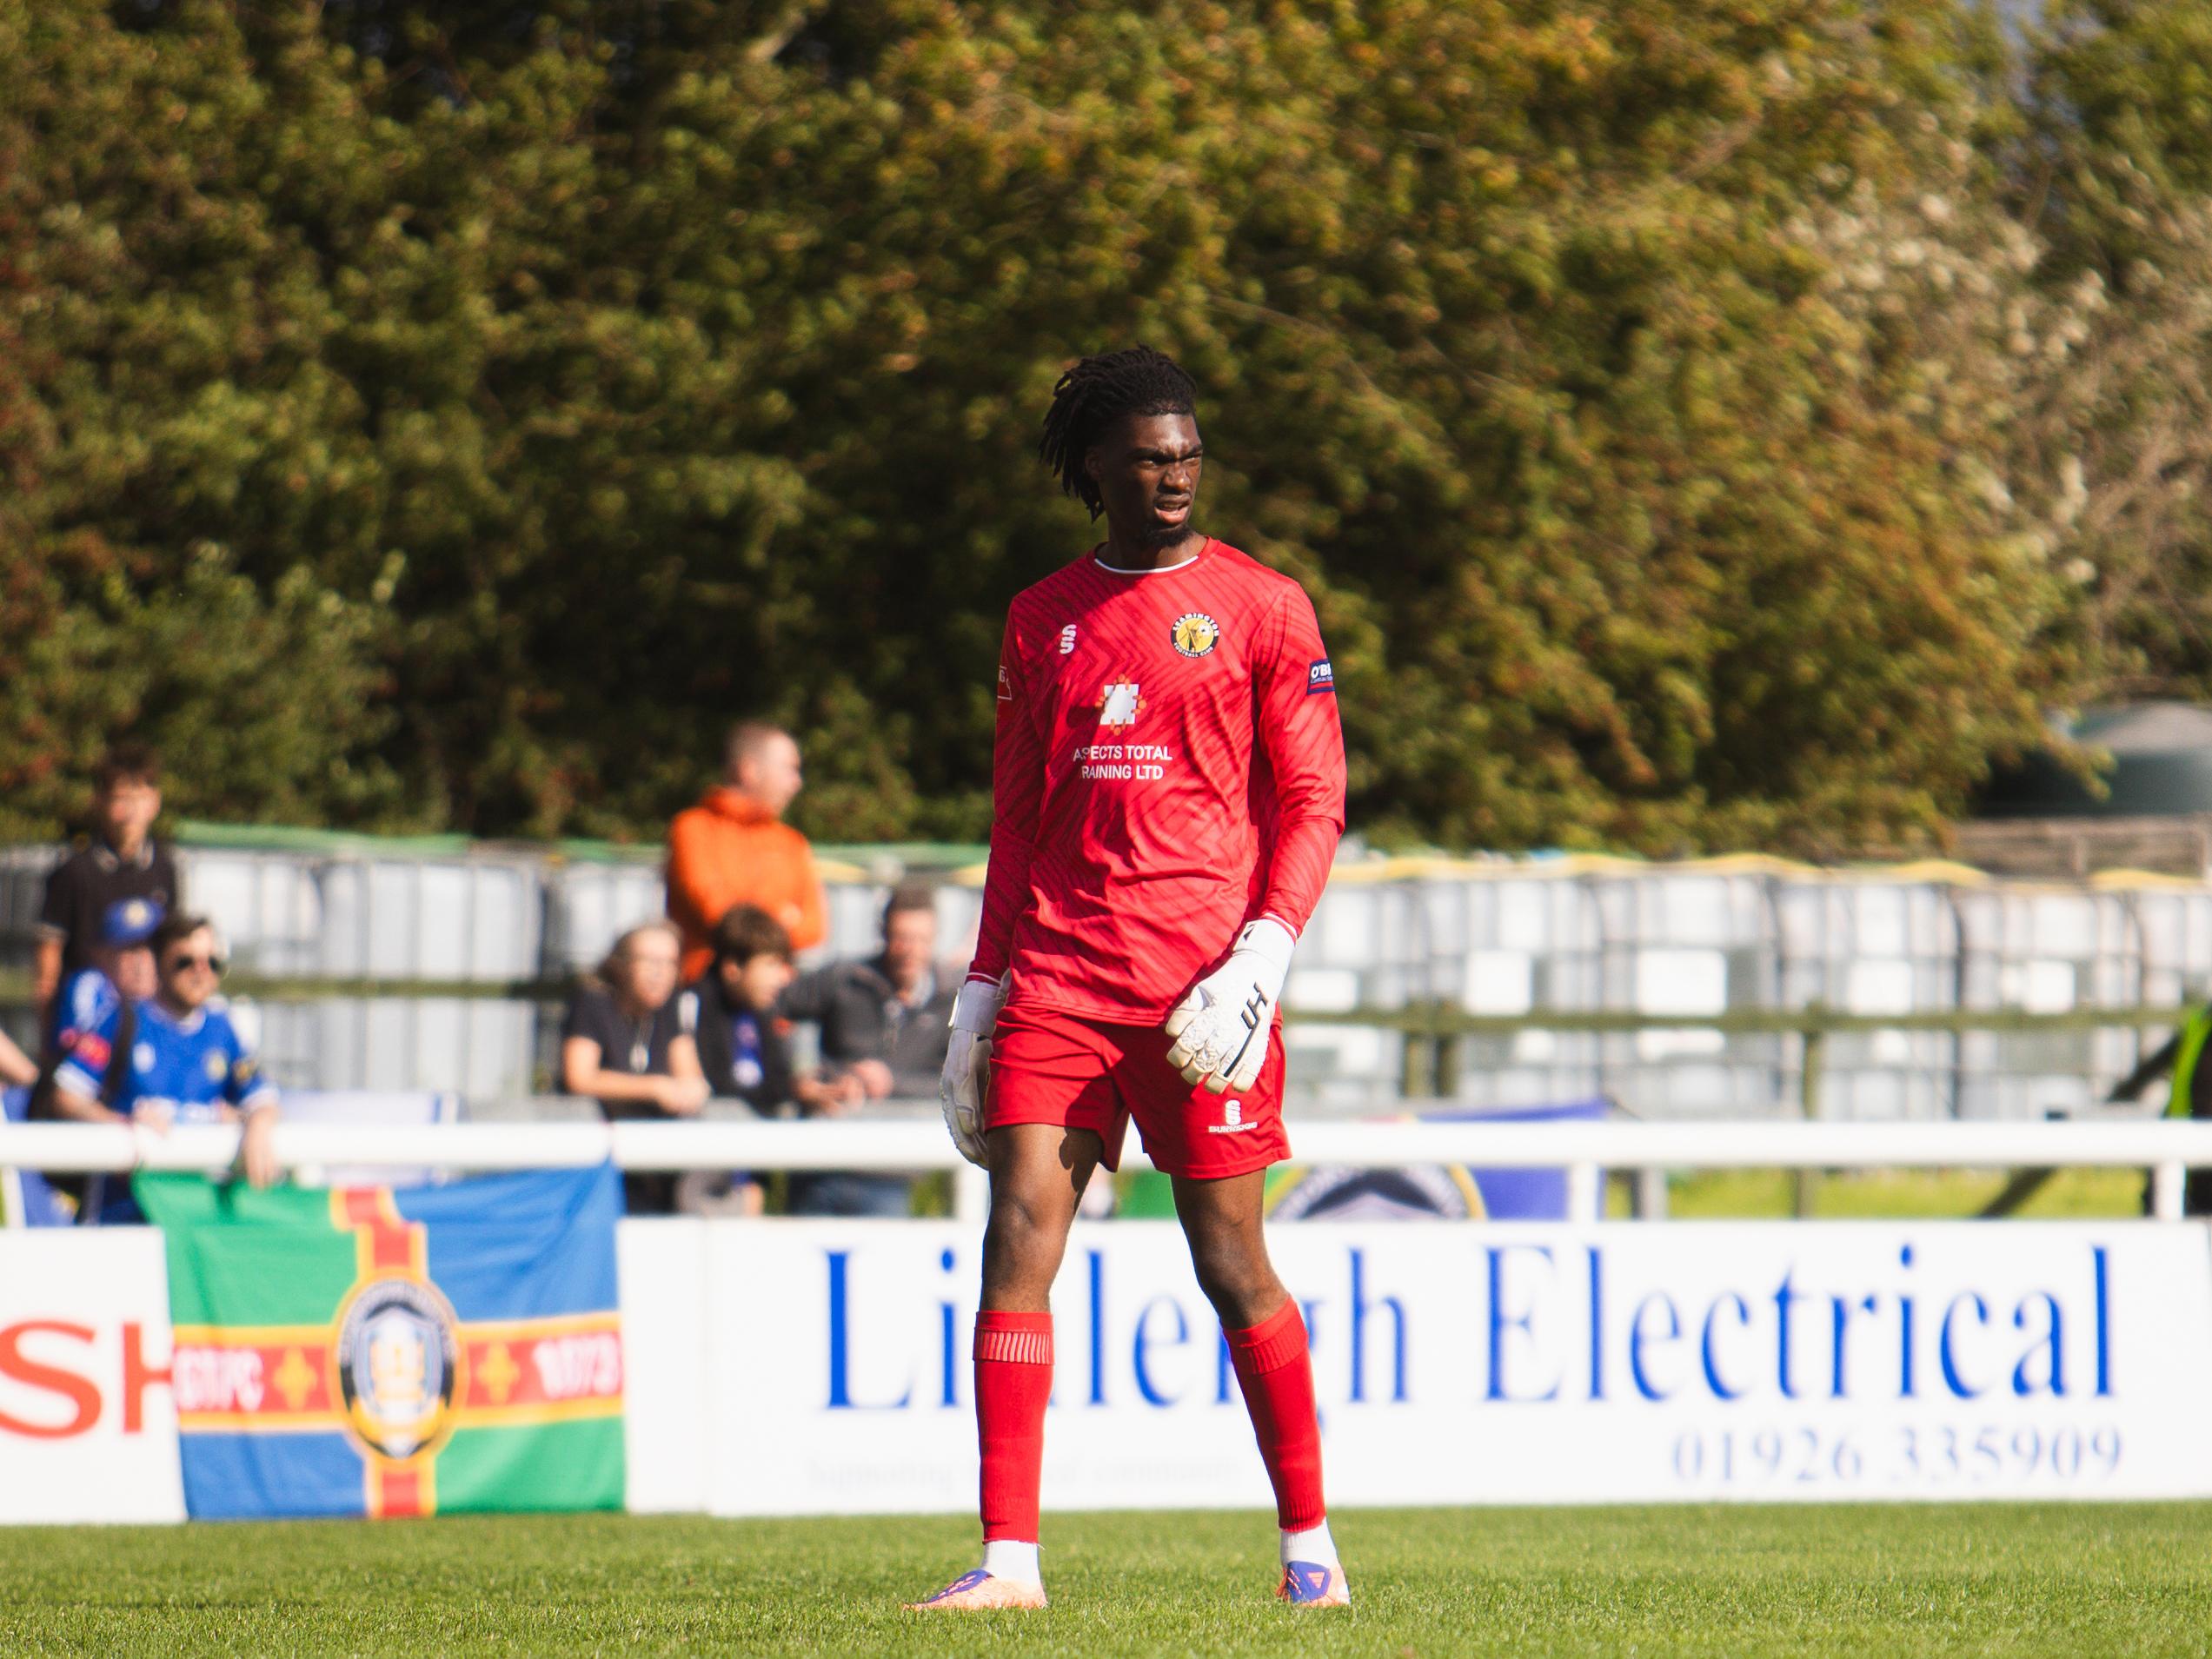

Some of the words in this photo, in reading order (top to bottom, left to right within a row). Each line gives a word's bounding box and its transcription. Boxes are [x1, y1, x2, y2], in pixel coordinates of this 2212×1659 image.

[1172, 613, 1219, 636] LEAMINGTON
[1126, 745, 1172, 760] TOTAL
[1080, 765, 1132, 780] RAINING
[1136, 765, 1164, 780] LTD
[820, 1246, 1413, 1439] Lileh
[1483, 1243, 2116, 1403] Electrical
[1672, 1426, 1863, 1483] 01926
[1891, 1426, 2123, 1483] 335909
